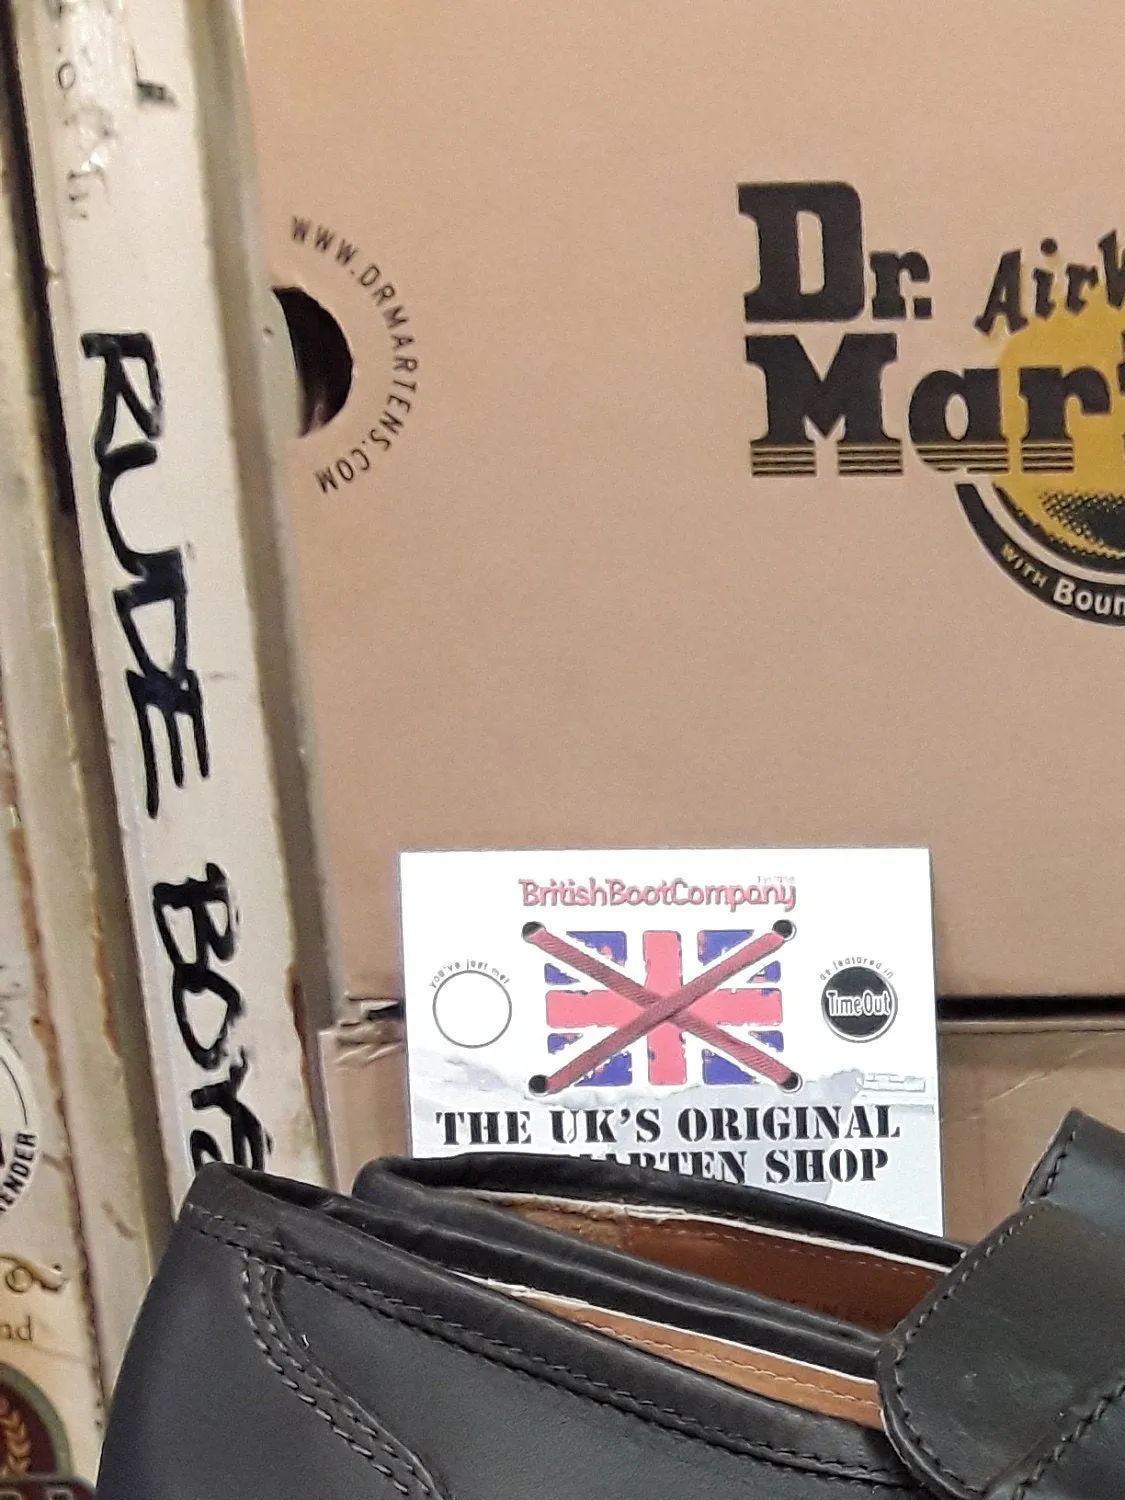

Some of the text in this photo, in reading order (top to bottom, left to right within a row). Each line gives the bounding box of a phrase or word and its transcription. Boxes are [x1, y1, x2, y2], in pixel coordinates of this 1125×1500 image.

[738, 181, 933, 323] Dr.
[291, 215, 418, 494] WWW.DRMARTENS.COM
[80, 332, 210, 820] RUDE
[1001, 543, 1047, 588] WITH
[518, 877, 797, 912] BritishBootCompany
[436, 1103, 901, 1146] THE UK'S ORIGINAL
[764, 1147, 889, 1184] SHOP
